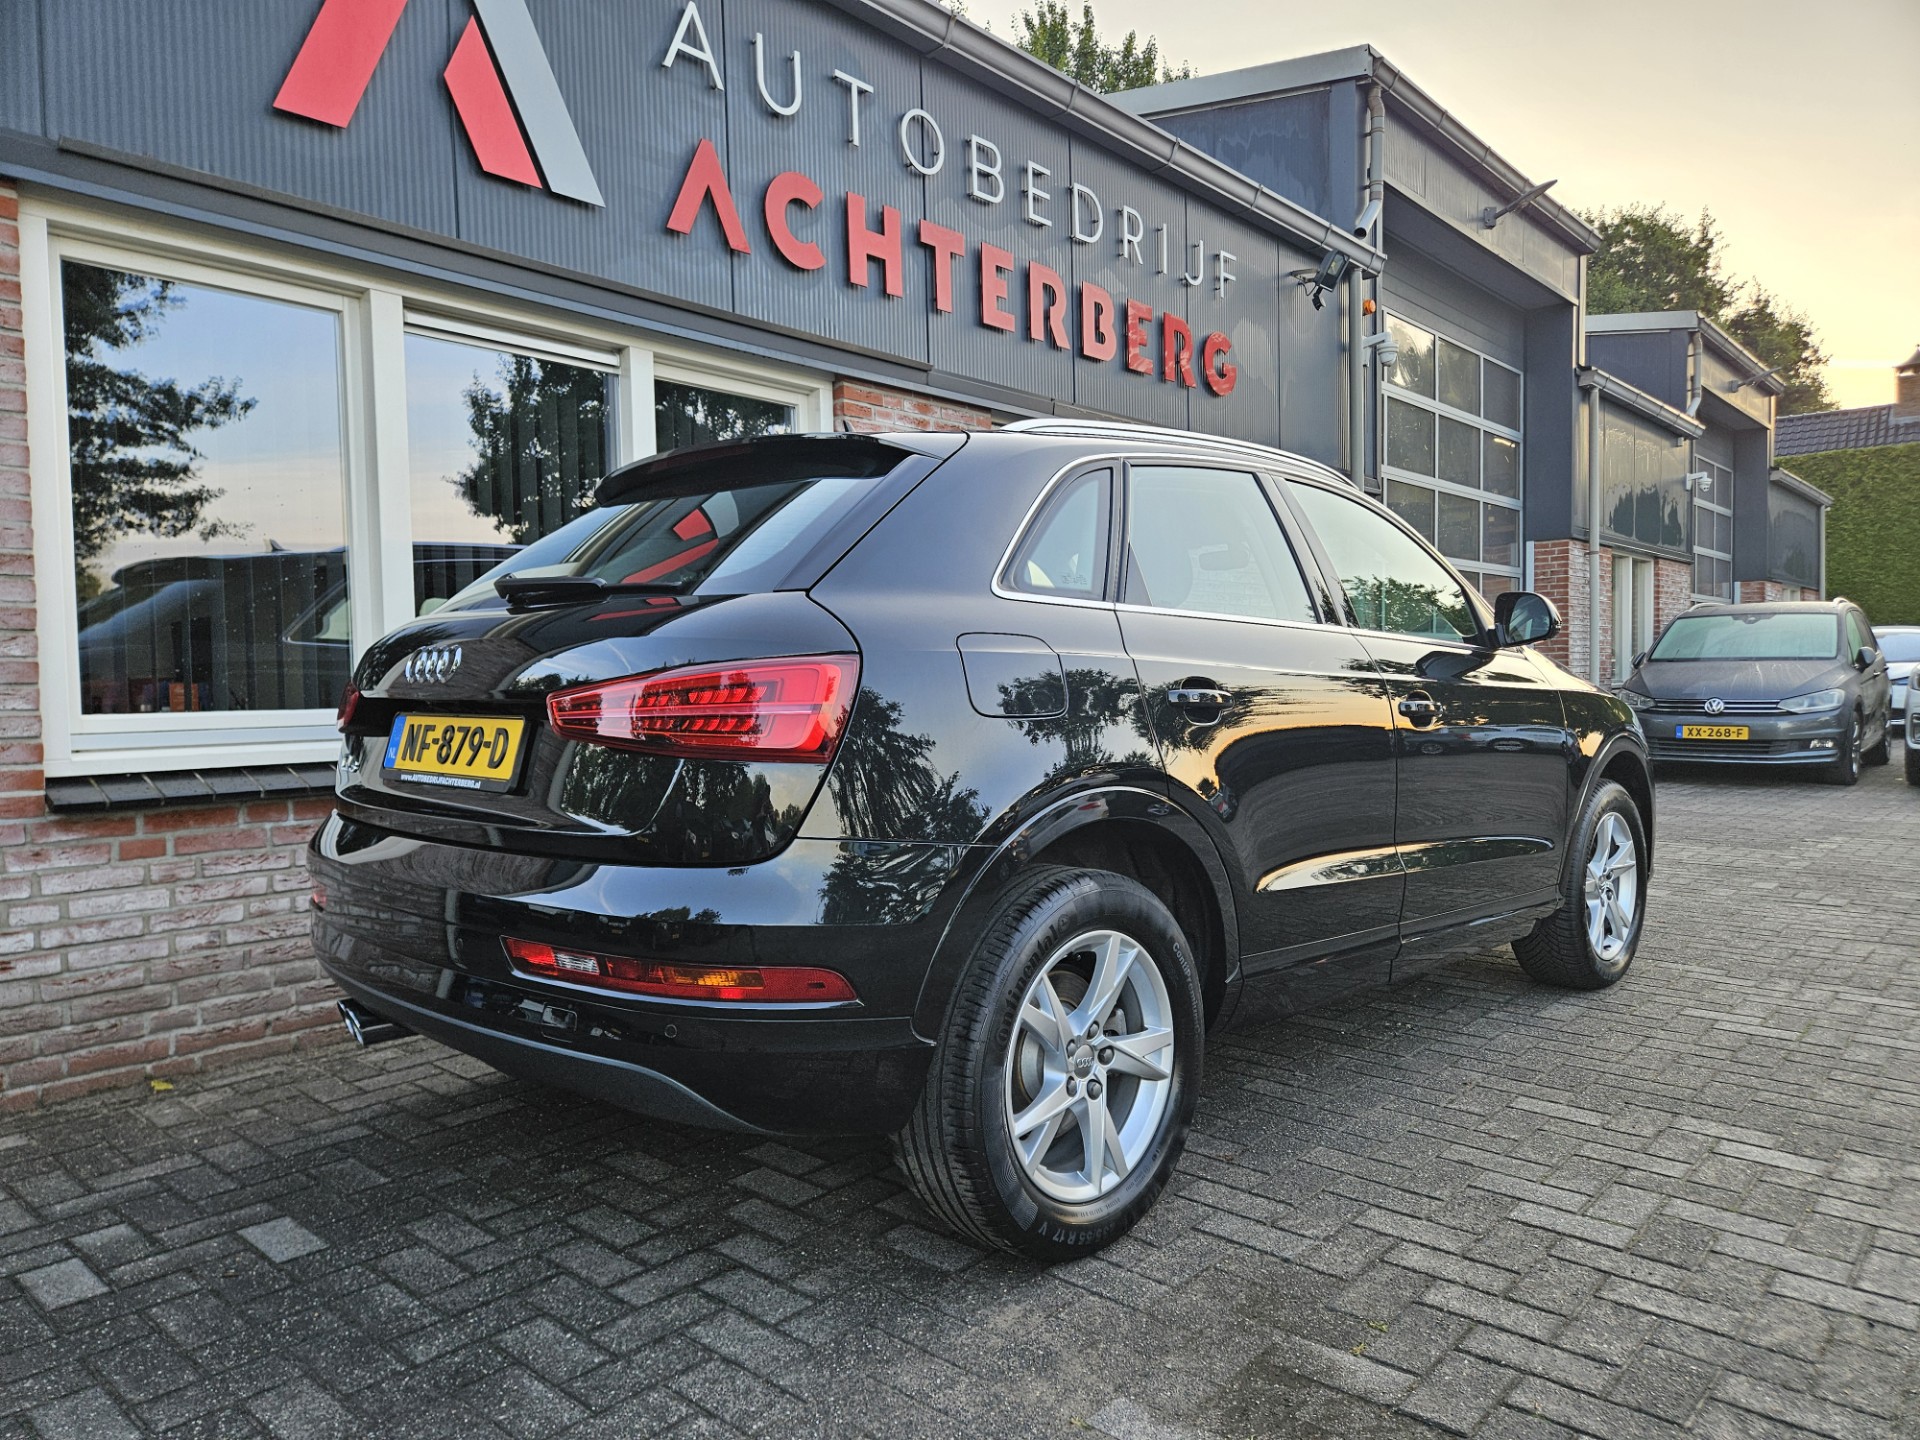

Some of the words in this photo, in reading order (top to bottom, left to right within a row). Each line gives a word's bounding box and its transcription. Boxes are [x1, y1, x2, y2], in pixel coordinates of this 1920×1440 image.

[662, 1, 1237, 298] AUTOBEDRIJF
[666, 138, 1237, 396] ACHTERBERG
[401, 724, 510, 769] NF-879-D
[1687, 727, 1744, 738] XX-268-F
